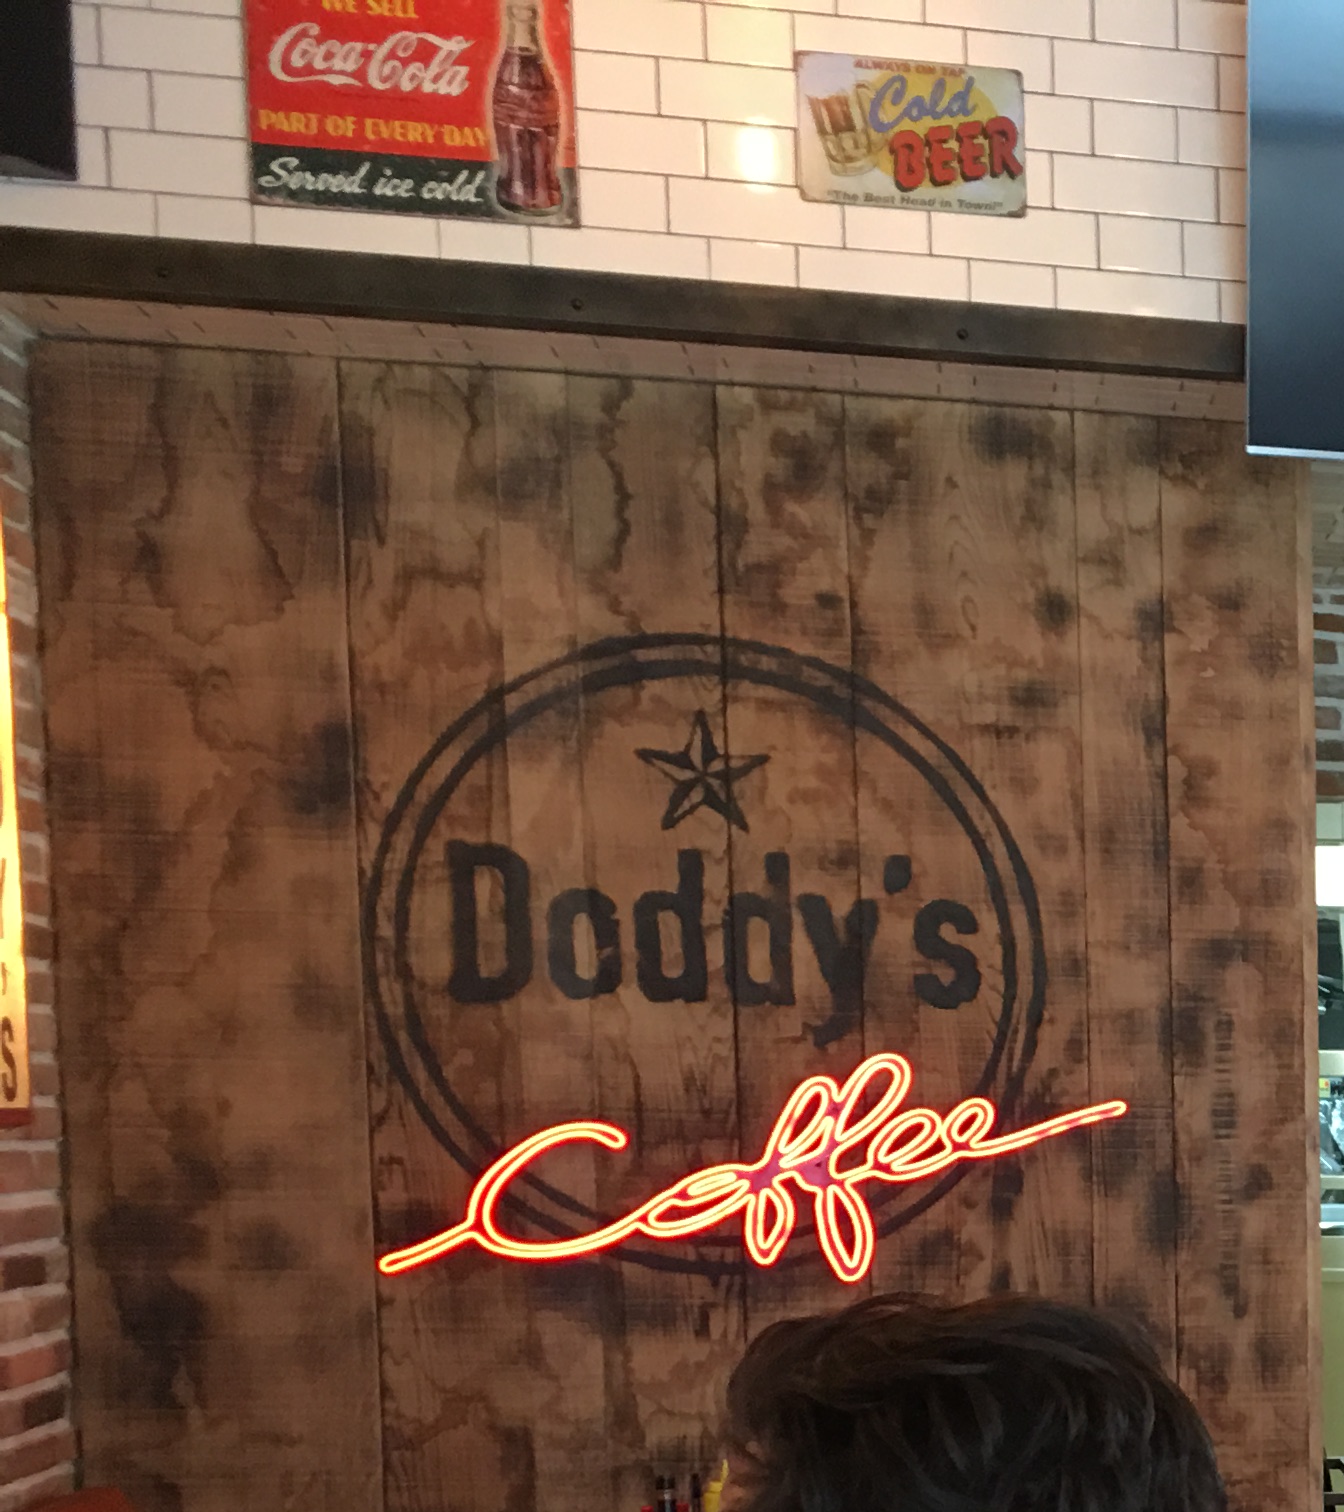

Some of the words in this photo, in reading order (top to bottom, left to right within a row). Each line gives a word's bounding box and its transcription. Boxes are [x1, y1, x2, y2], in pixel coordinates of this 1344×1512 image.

[321, 0, 358, 13] WE
[367, 0, 420, 18] SELL
[268, 22, 477, 97] Coca-Cola
[853, 58, 912, 73] ALWAYS
[915, 63, 937, 75] ON
[257, 109, 319, 135] PART
[325, 115, 358, 138] OF
[365, 118, 440, 144] EVERY
[441, 124, 492, 148] DAY
[868, 74, 978, 133] Cold
[258, 156, 370, 194] Served
[372, 167, 416, 198] ice
[419, 169, 487, 203] cold
[889, 115, 1025, 192] BEER
[863, 191, 897, 205] Best
[444, 839, 983, 1048] Doddy's
[379, 1052, 1128, 1282] Coffee
